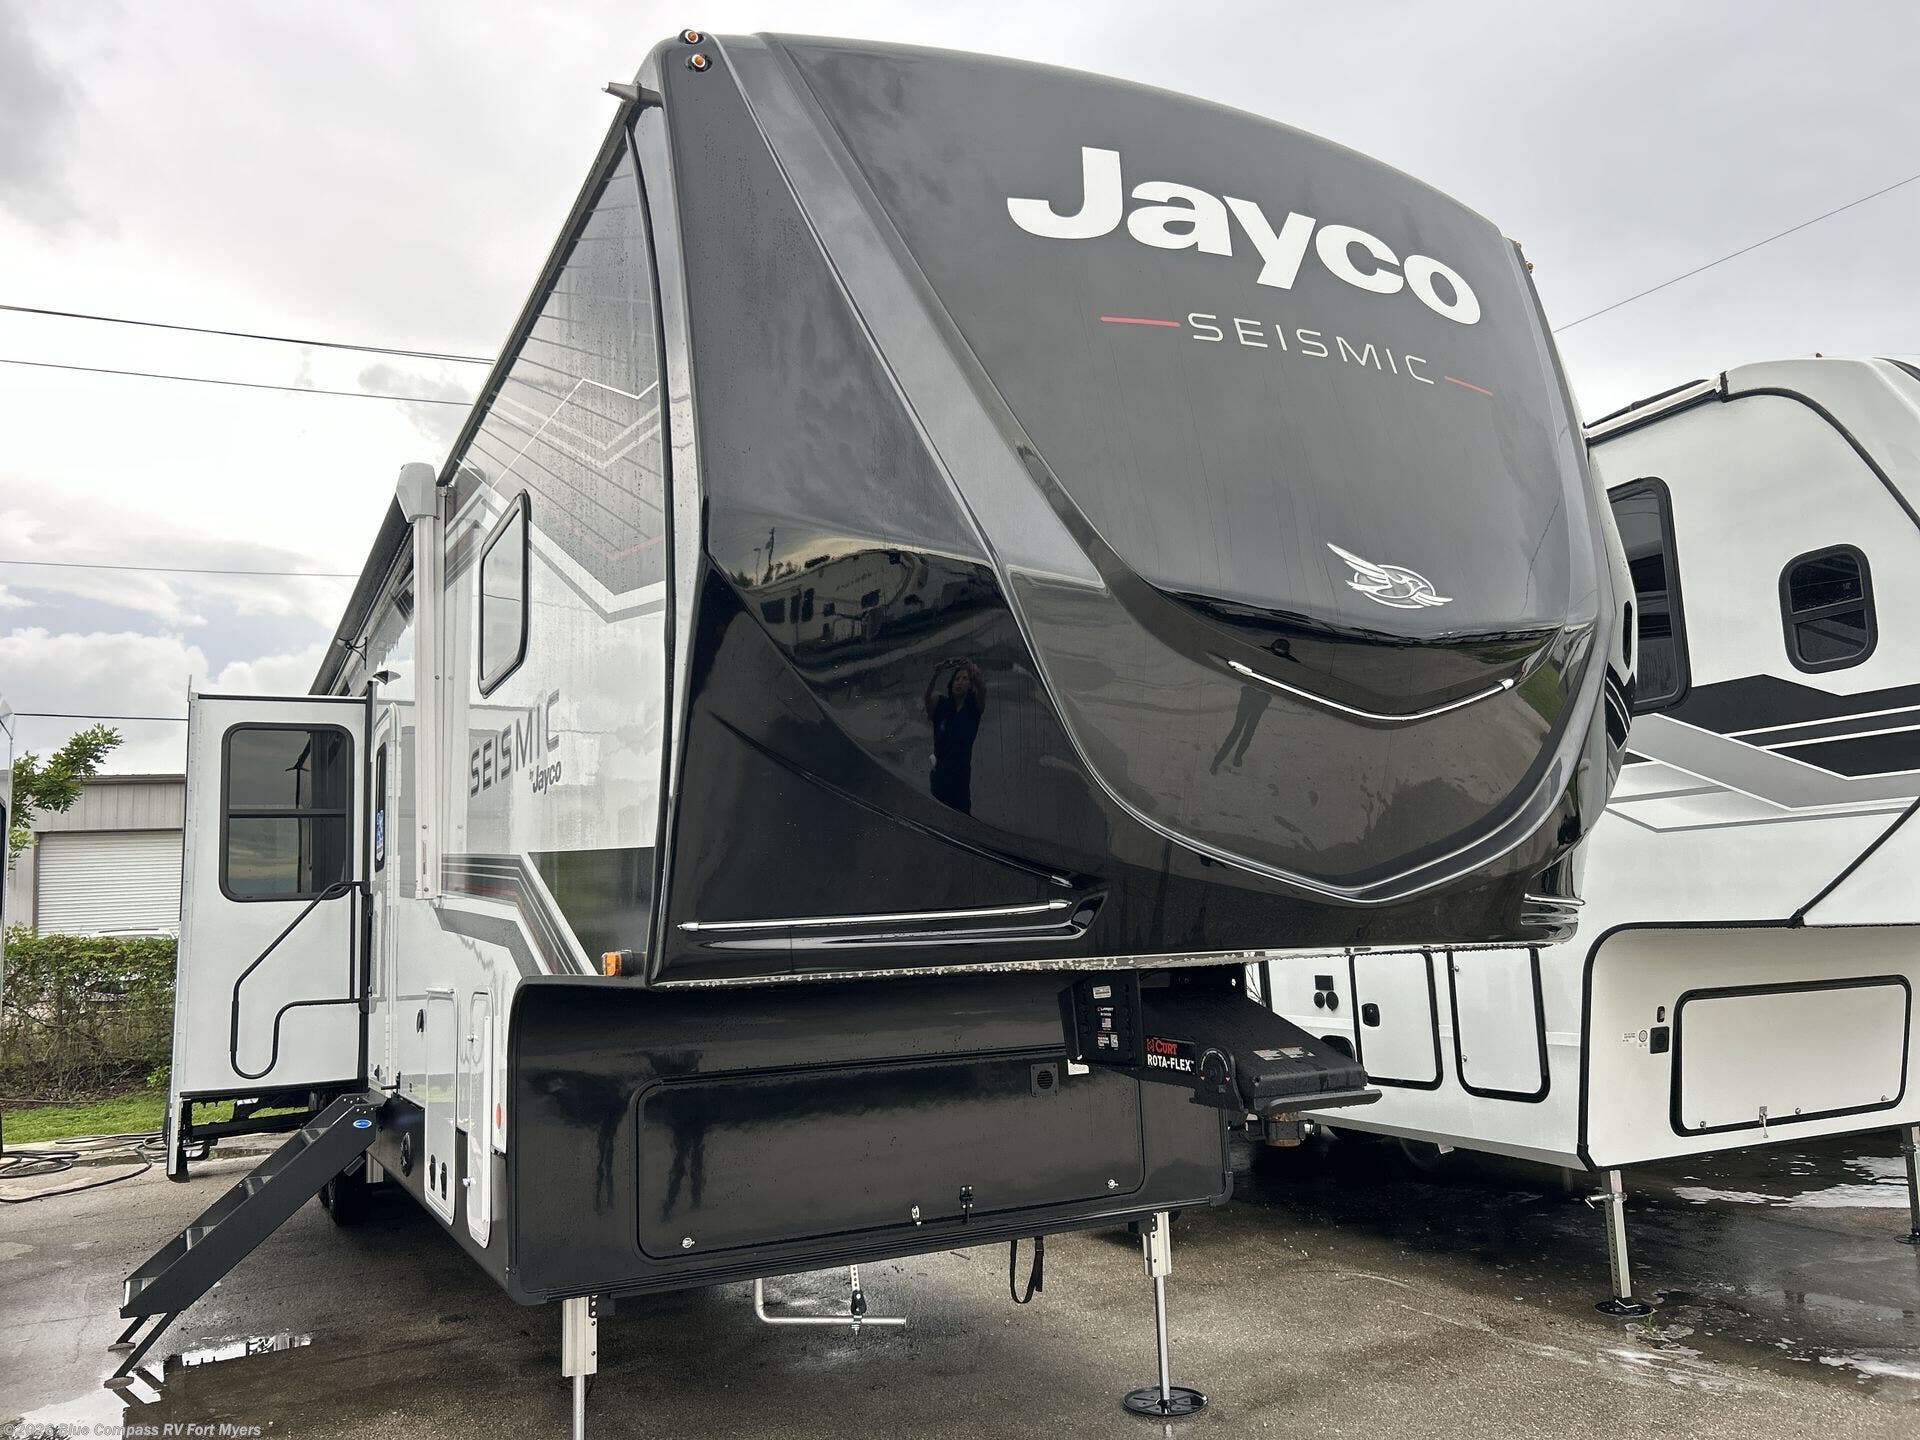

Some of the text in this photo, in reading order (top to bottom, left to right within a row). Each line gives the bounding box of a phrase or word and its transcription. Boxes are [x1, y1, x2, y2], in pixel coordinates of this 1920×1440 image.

[1007, 146, 1481, 325] Jayco
[1188, 313, 1435, 384] SEISMIC
[470, 688, 560, 798] SEISMIC
[533, 761, 562, 795] Jayco
[1155, 1040, 1178, 1055] CURT
